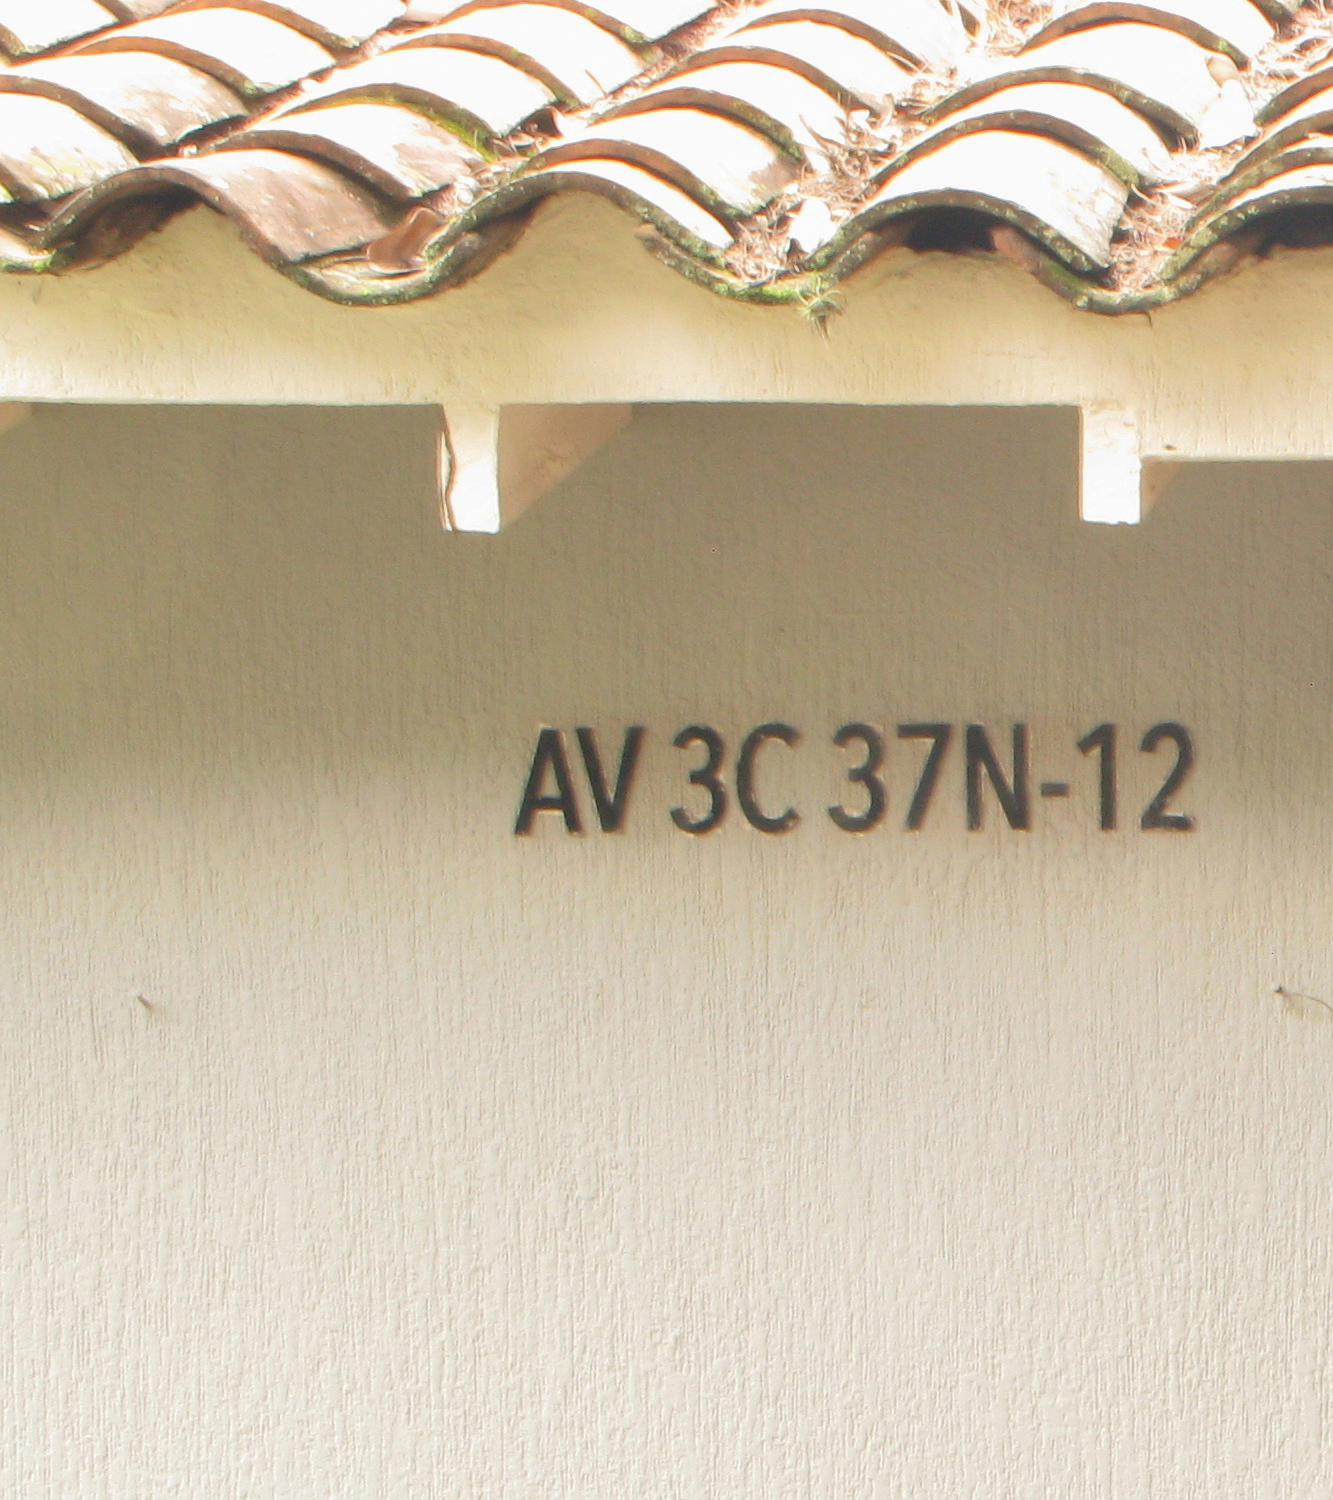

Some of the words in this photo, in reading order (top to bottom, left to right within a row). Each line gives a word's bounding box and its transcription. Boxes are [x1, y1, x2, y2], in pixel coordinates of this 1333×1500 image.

[513, 725, 646, 837] AV
[669, 722, 802, 835] 3C
[827, 721, 1197, 836] 37N-12
